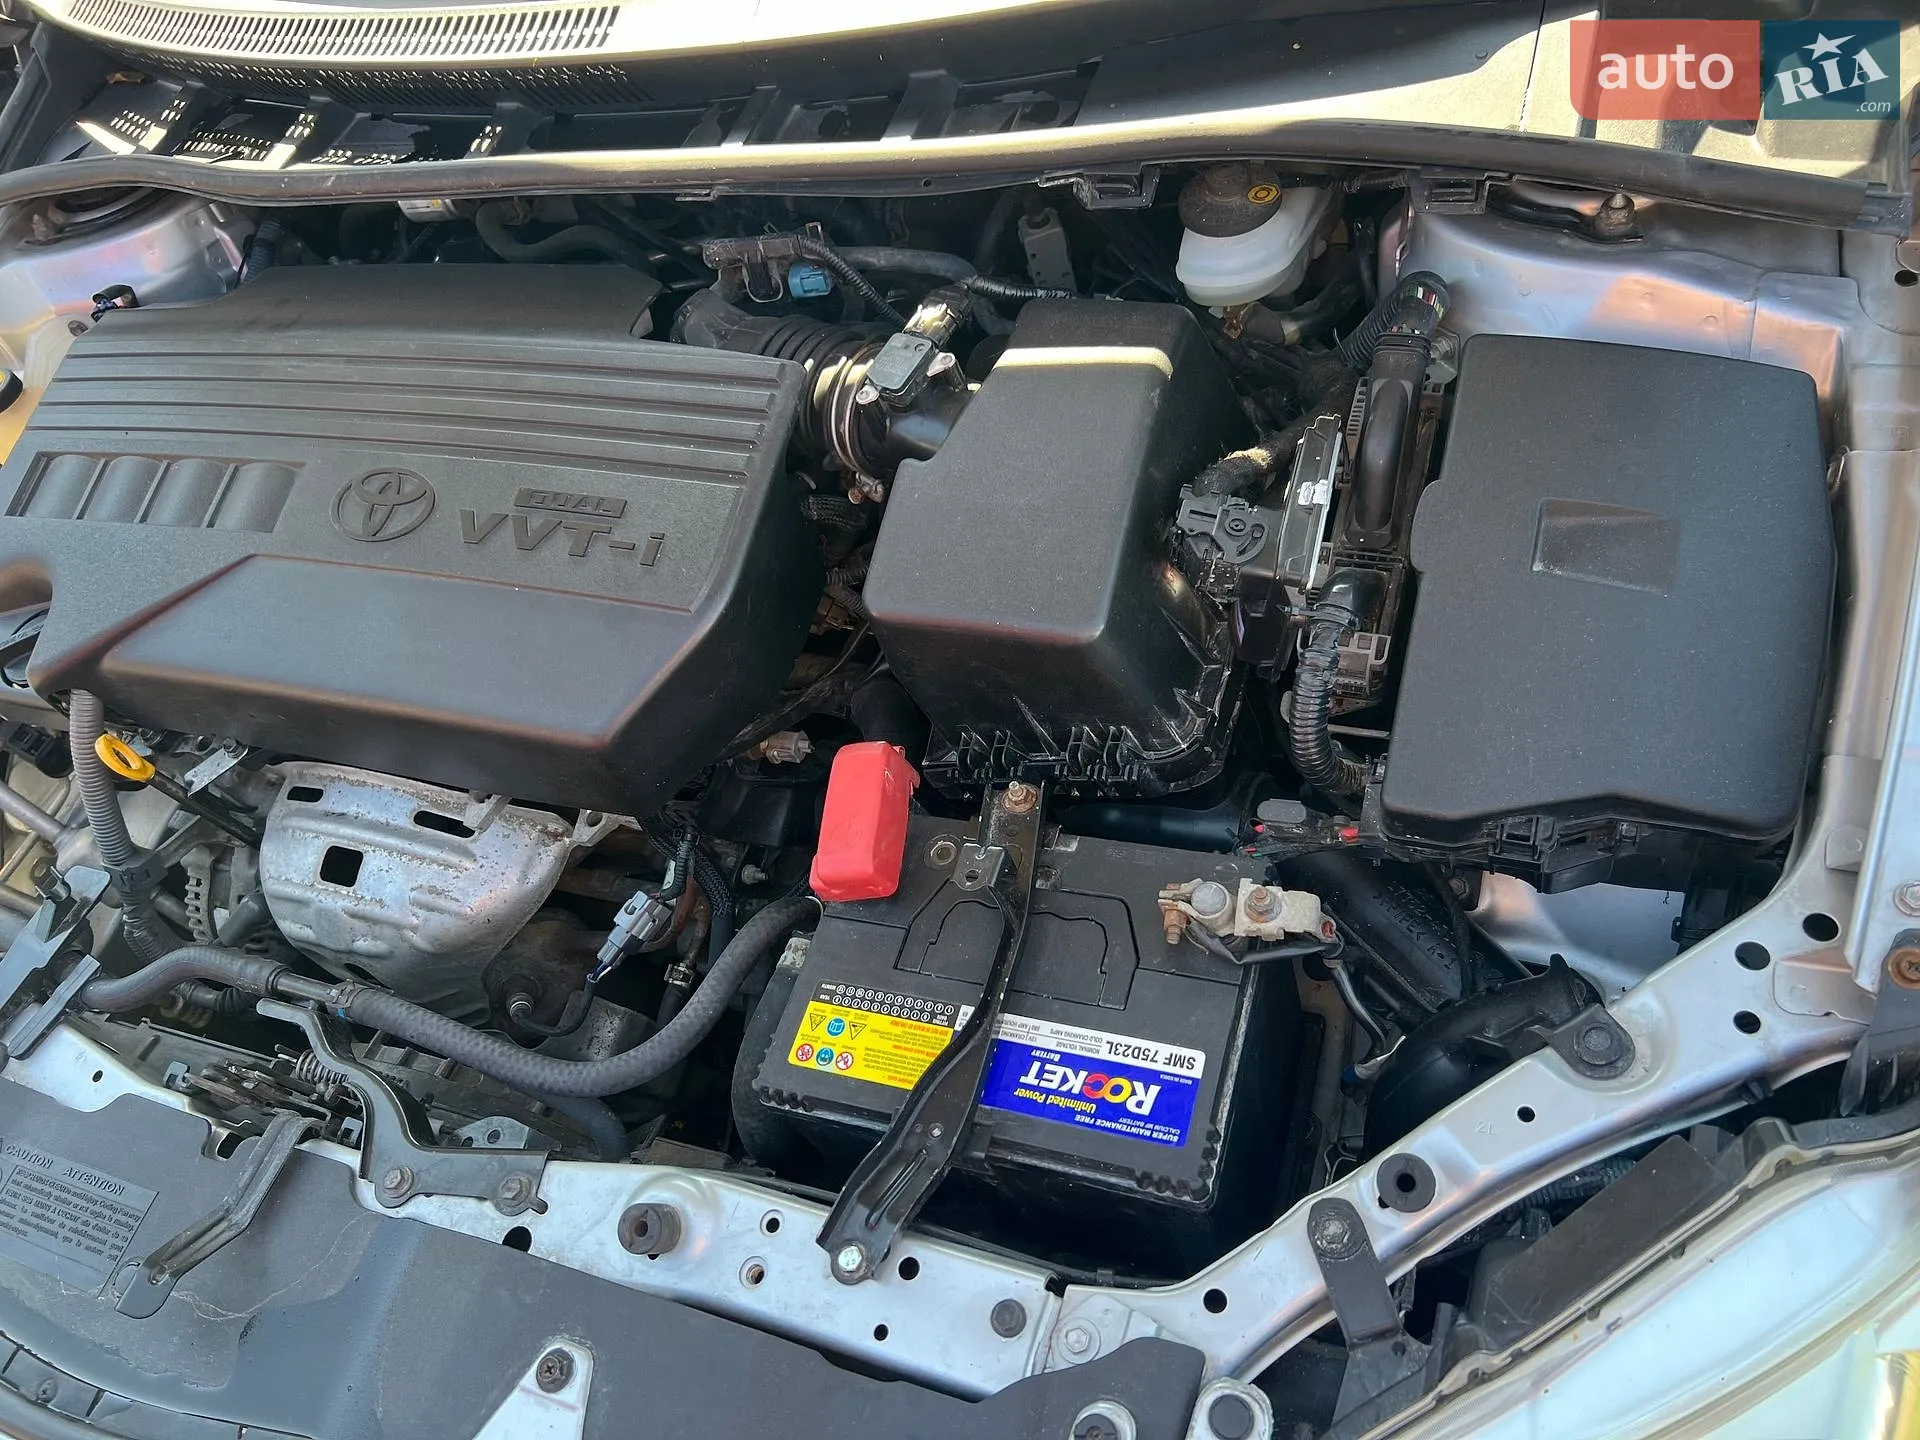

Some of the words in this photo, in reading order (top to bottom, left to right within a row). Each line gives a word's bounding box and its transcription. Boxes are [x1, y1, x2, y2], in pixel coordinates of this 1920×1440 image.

[527, 490, 613, 513] DUAL
[459, 508, 665, 567] VVT-i
[1056, 1041, 1078, 1051] VOLTAGE
[1106, 1041, 1159, 1063] 75D23L
[1031, 1049, 1061, 1062] BATTERY
[1163, 1052, 1196, 1070] SMF
[1014, 1088, 1046, 1103] Power
[1019, 1060, 1161, 1116] ROCKET
[1046, 1094, 1096, 1114] Unlimited
[1074, 1114, 1095, 1125] FREE
[1095, 1118, 1154, 1137] MAINTENANCE
[1119, 1117, 1148, 1127] BATTERY
[1152, 1131, 1179, 1142] SUPER
[1154, 1124, 1180, 1135] CALCIUM
[6, 1144, 54, 1169] CAUTION
[61, 1167, 125, 1196] ATTENTION
